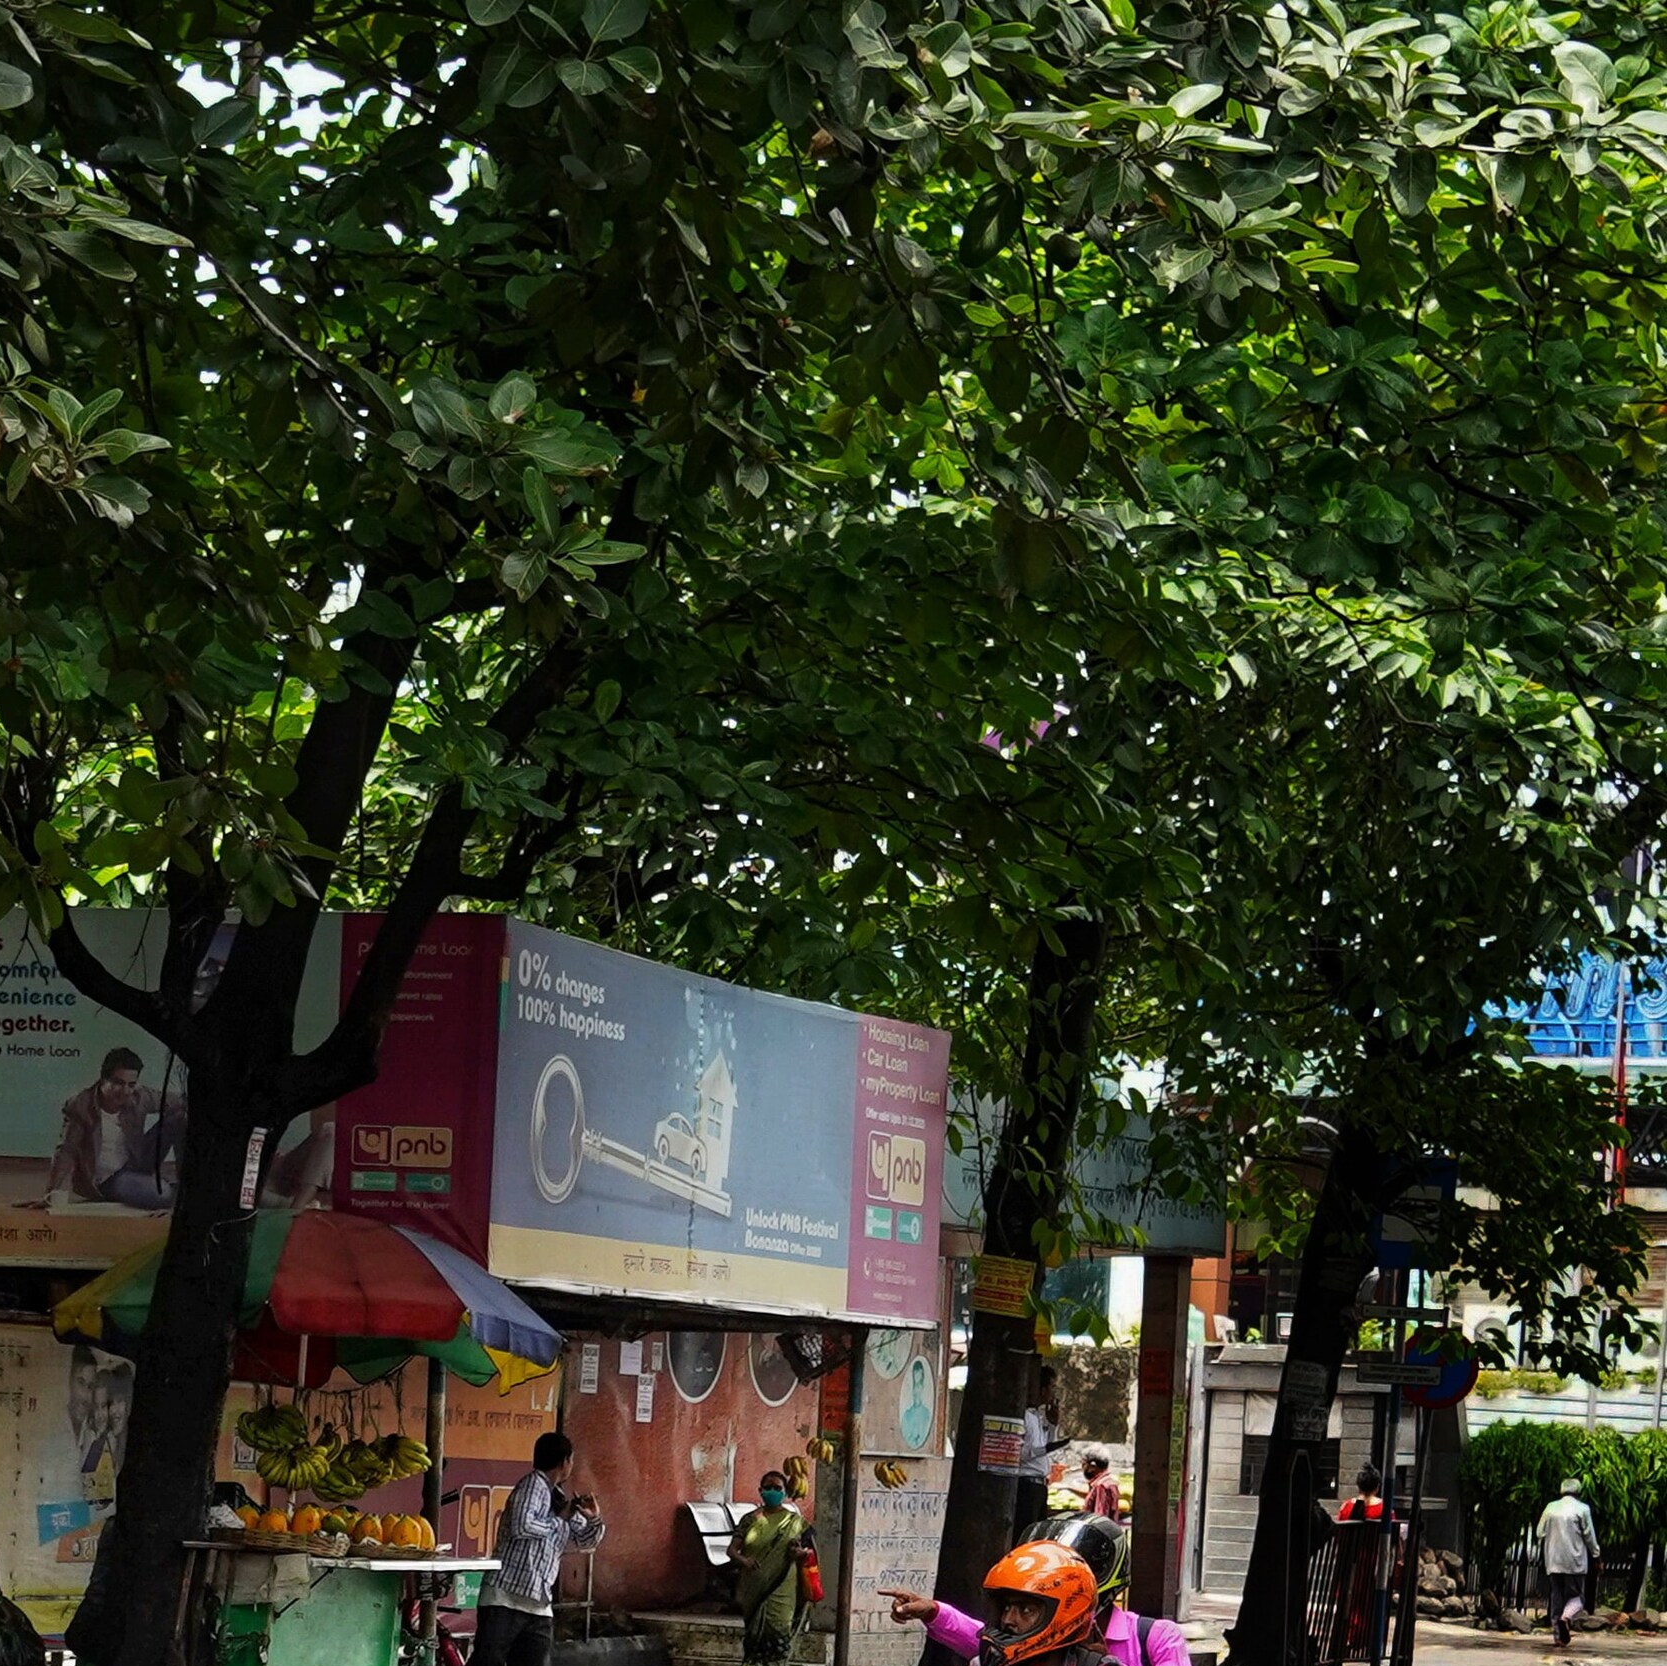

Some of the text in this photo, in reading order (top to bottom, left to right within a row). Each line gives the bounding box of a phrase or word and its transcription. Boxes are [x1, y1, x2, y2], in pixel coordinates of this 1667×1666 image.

[518, 949, 605, 1007] 0% charges
[517, 993, 625, 1041] 100% happiness
[7, 1043, 45, 1057] Home
[49, 1044, 80, 1057] Loan
[868, 1022, 930, 1052] Housing Loan
[867, 1047, 908, 1073] Car Loan
[866, 1076, 941, 1106] myProperty Loan
[396, 1132, 447, 1161] pnb
[892, 1147, 922, 1193] pnb
[746, 1207, 839, 1240] Unlock PNB Festival
[744, 1228, 789, 1254] Bonanza
